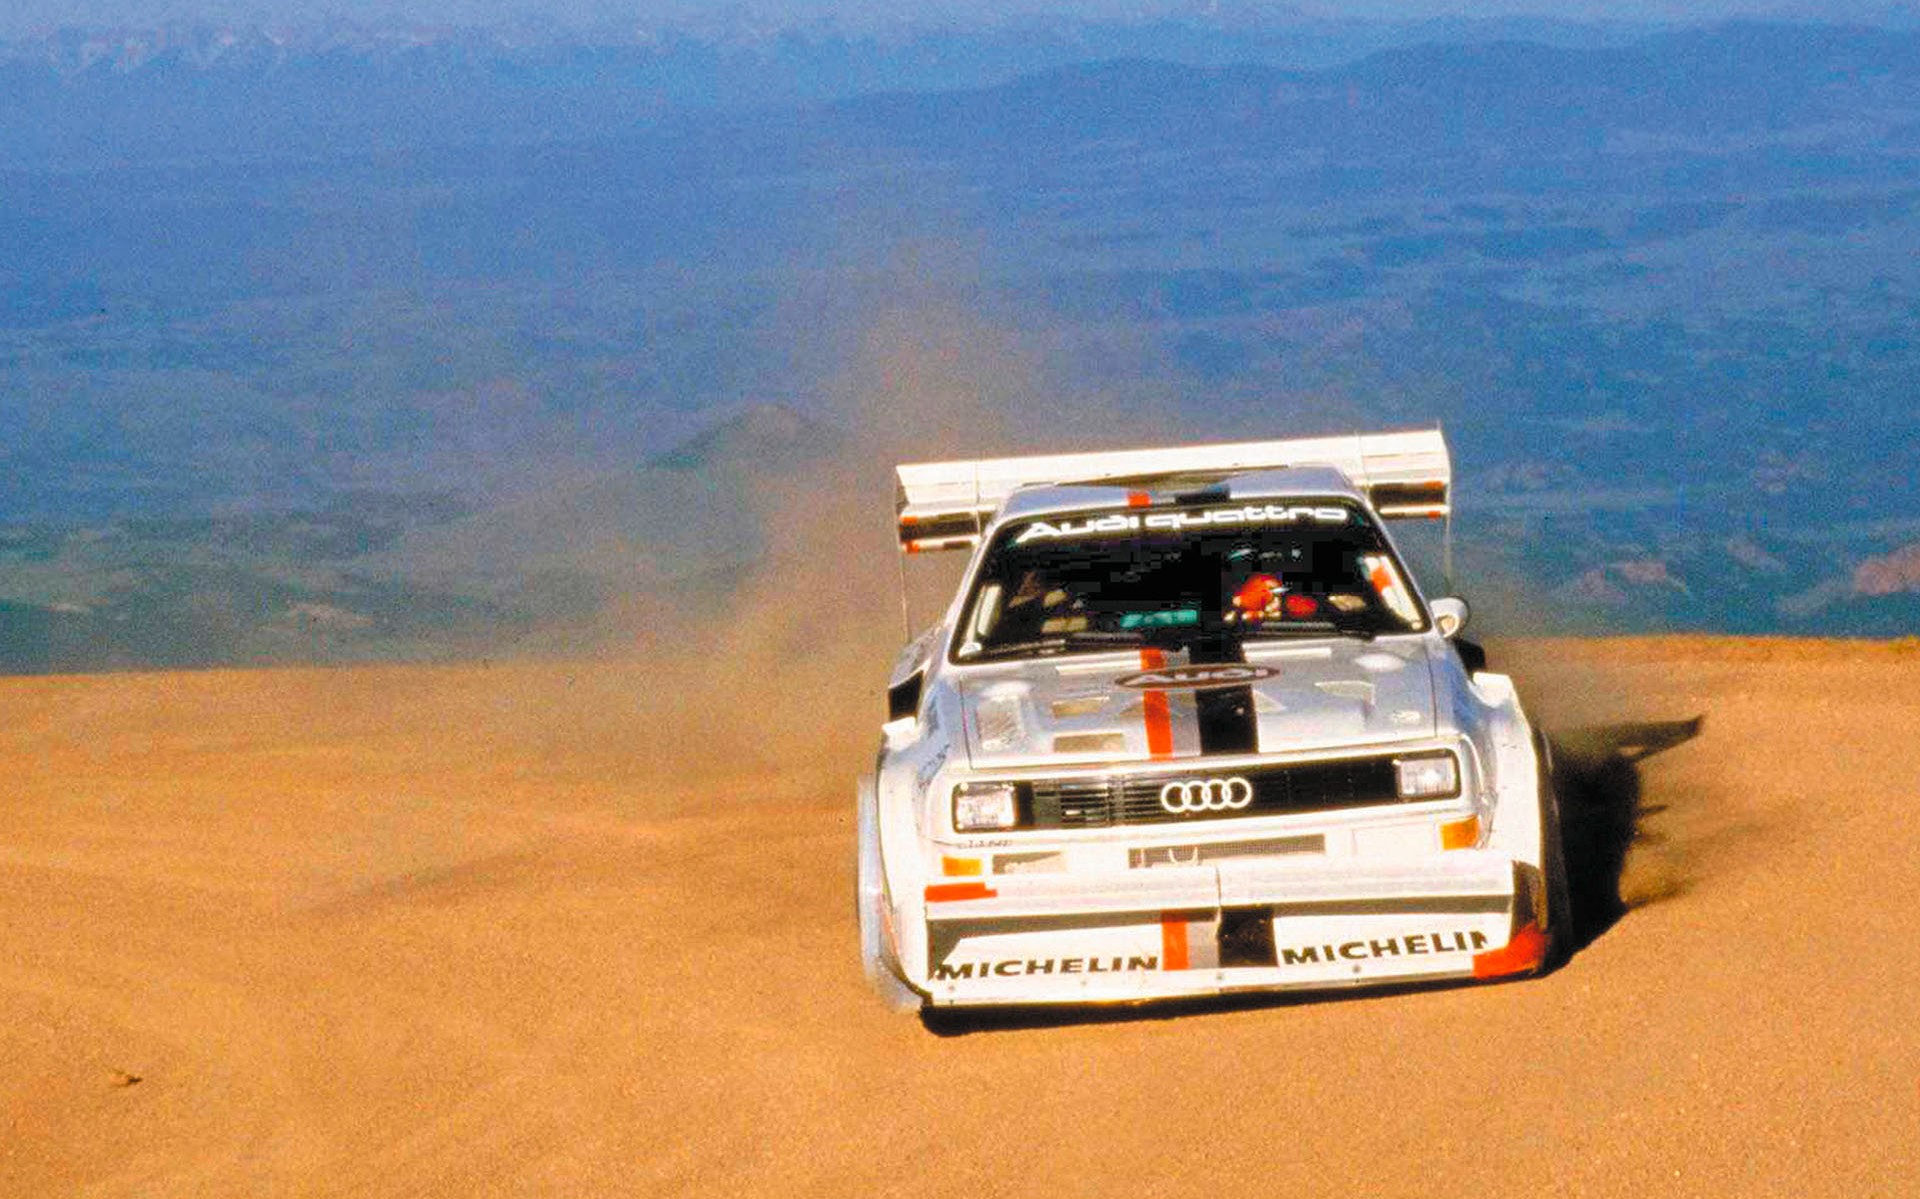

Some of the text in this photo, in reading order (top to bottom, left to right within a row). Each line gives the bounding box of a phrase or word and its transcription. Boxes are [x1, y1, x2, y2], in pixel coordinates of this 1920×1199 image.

[1015, 506, 1347, 544] Audi quattro
[935, 956, 1159, 981] MICHELIN
